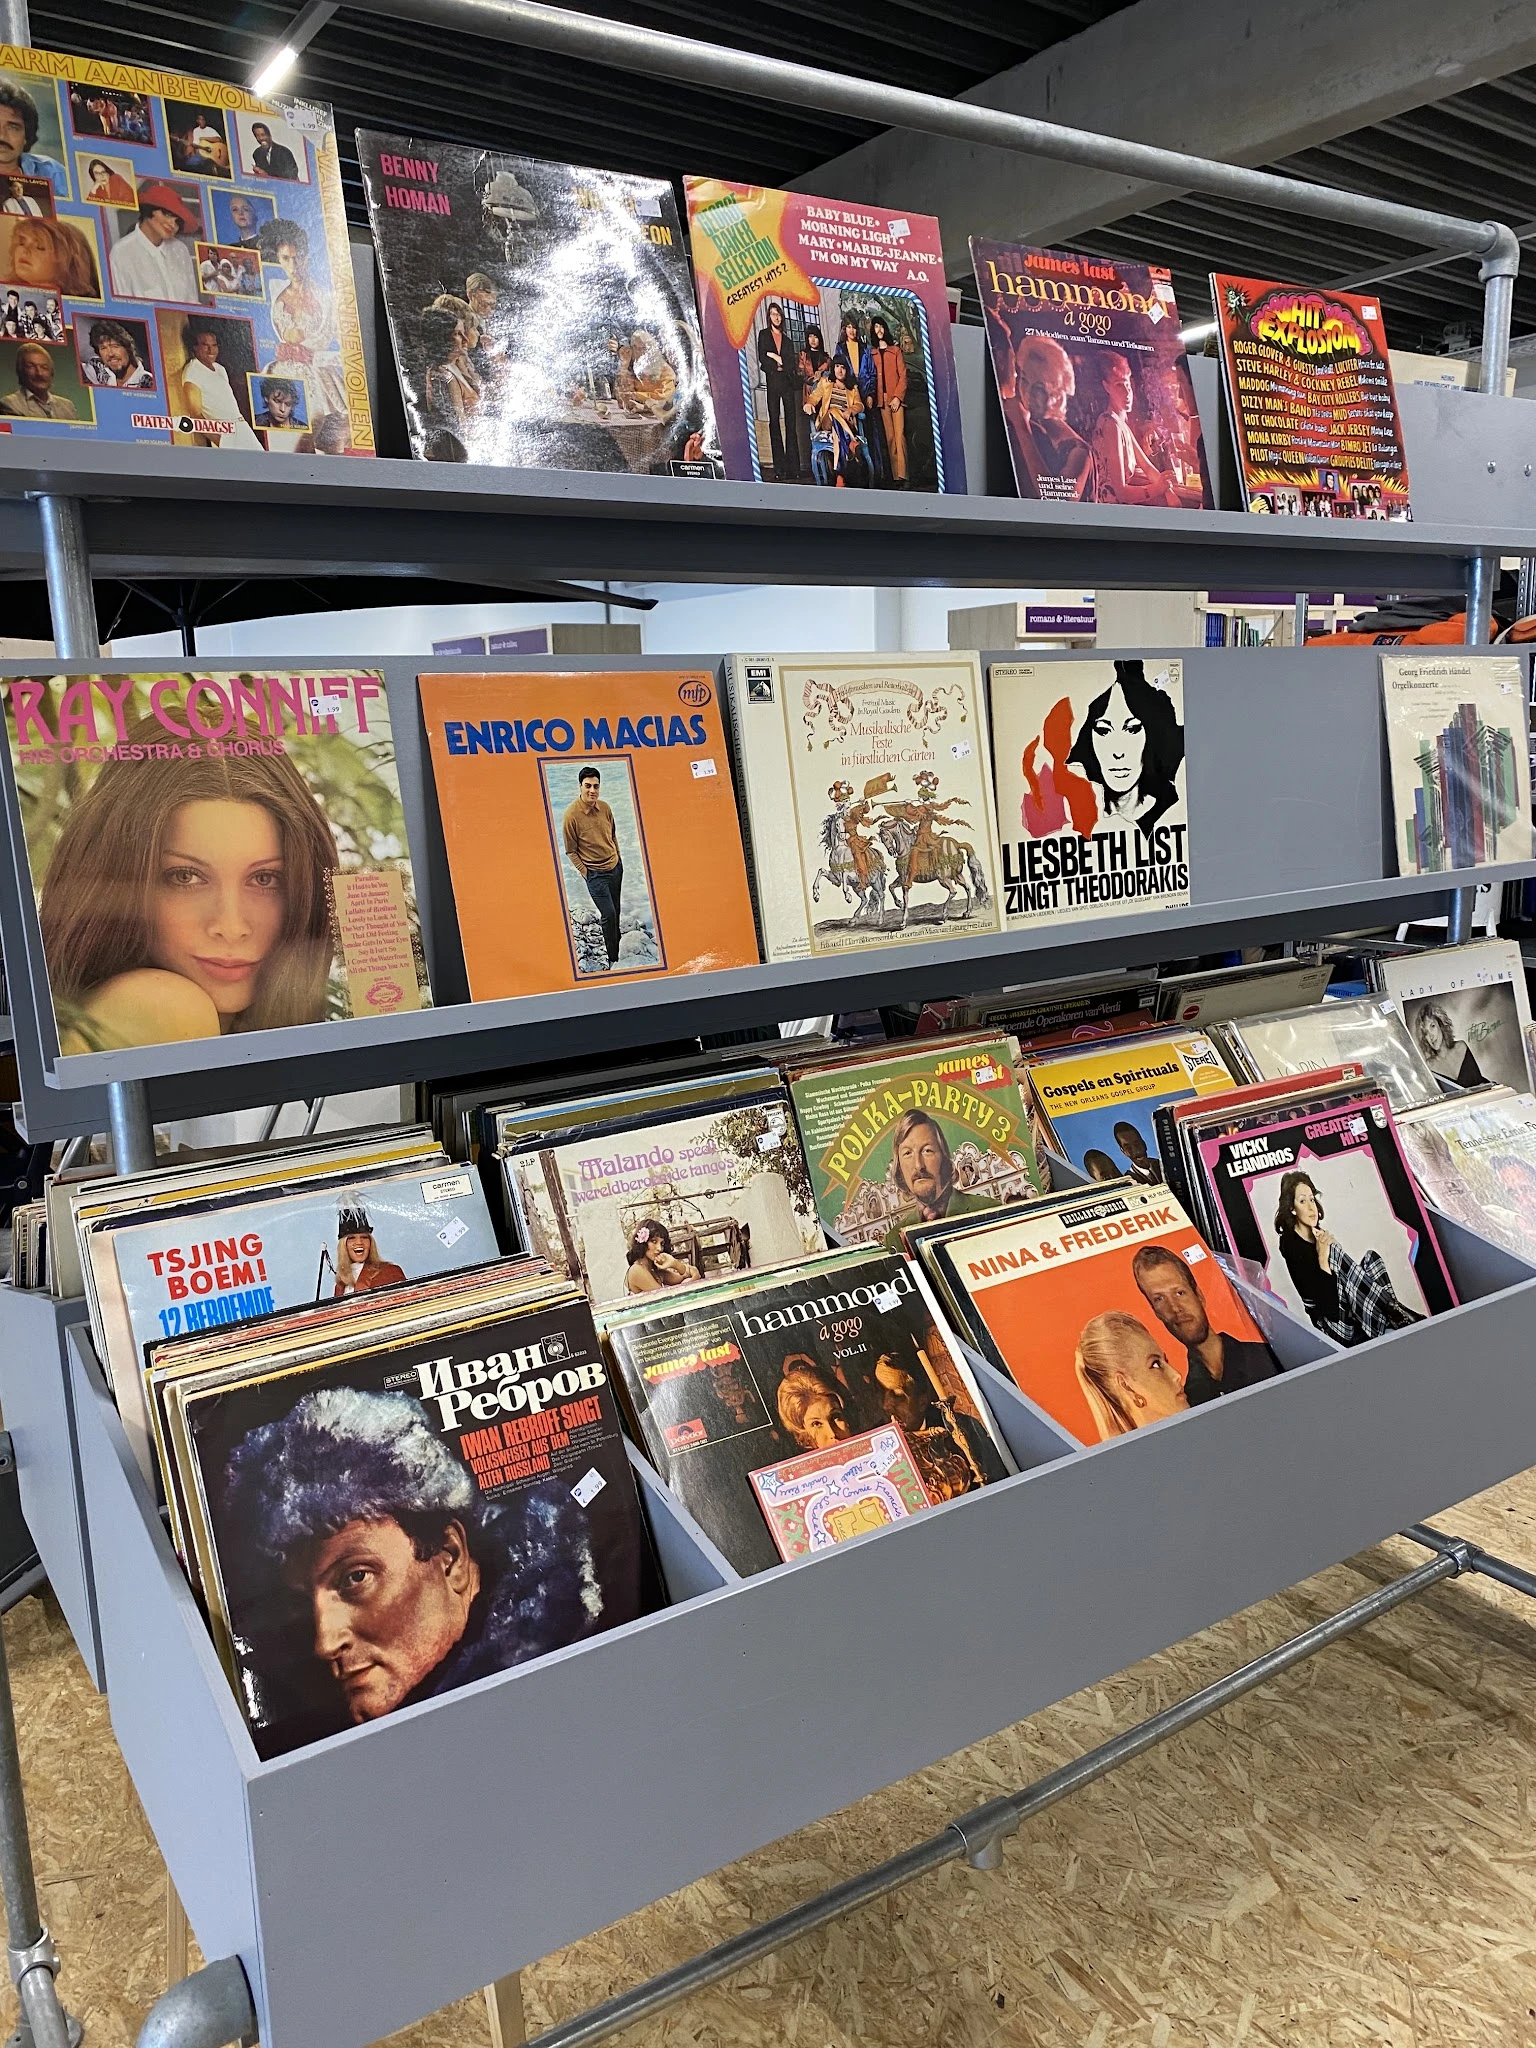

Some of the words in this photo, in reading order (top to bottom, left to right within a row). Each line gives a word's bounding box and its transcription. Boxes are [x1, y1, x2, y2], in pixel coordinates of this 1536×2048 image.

[85, 61, 282, 117] AANBEVOL
[379, 153, 439, 184] BENNY
[385, 185, 452, 216] HOMAN
[696, 191, 745, 238] GEORGE
[806, 205, 843, 221] BABY
[843, 212, 875, 227] BLUE
[711, 218, 758, 262] BAKER
[800, 219, 861, 240] MORNING
[861, 228, 899, 246] LIGHT
[714, 236, 781, 291] SELECTION
[798, 234, 836, 249] MARY
[842, 241, 937, 265] MARIE-JEANNE
[810, 250, 827, 262] I'M
[830, 253, 849, 266] ON
[849, 255, 869, 268] MY
[870, 257, 900, 273] WAY
[726, 276, 765, 306] GREATEST
[765, 268, 781, 285] HITS
[781, 262, 789, 273] 2
[906, 268, 930, 283] A.O.
[986, 260, 1172, 319] hammond
[1078, 311, 1112, 337] gogo
[1290, 298, 1325, 330] HIT
[1024, 327, 1035, 337] 27
[1035, 328, 1069, 342] Melodien
[1085, 334, 1111, 347] Tanzen
[1111, 338, 1124, 349] und
[1124, 339, 1155, 352] Träumen
[1261, 310, 1361, 355] EXPLOSION
[1233, 340, 1258, 355] ROGER
[1258, 344, 1284, 365] GLOVER
[1285, 356, 1291, 367] &
[1293, 359, 1315, 376] GUESTS
[1334, 357, 1359, 375] LUCIFER
[1236, 358, 1263, 373] STEVE
[1263, 362, 1292, 383] HARLEY
[1293, 373, 1299, 386] &
[1301, 376, 1336, 392] COCKNEY
[1336, 374, 1359, 390] REBEL
[1238, 376, 1271, 392] MADDOG
[1307, 391, 1321, 405] BAY
[1321, 393, 1335, 406] CITY
[1335, 390, 1361, 406] ROLLERS
[1240, 394, 1263, 409] DIZZY
[1264, 397, 1288, 412] MAN'S
[1289, 401, 1312, 418] BAND
[1333, 407, 1348, 421] MUD
[133, 415, 174, 429] PLATEN
[194, 419, 235, 434] DAAGSE
[1243, 412, 1260, 426] HOT
[1261, 414, 1299, 430] CHOCOLATE
[1329, 423, 1347, 436] JACK
[1347, 423, 1371, 437] JERSEY
[1247, 430, 1271, 445] MONA
[1270, 432, 1292, 446] KIRBY
[1340, 439, 1361, 453] BIMBO
[1361, 441, 1372, 453] JET
[1249, 447, 1269, 462] PILOT
[1282, 449, 1305, 465] QUEEN
[1030, 615, 1056, 623] romans
[750, 669, 767, 677] EMI
[1391, 680, 1440, 691] Orgelkonzerte
[1398, 667, 1418, 678] Georg
[1419, 666, 1448, 676] Friedrich
[1448, 666, 1472, 676] Händel
[683, 683, 707, 702] mfp
[10, 678, 136, 747] RAY
[149, 675, 381, 740] CONNIFF
[326, 705, 341, 714] 1.99
[444, 718, 575, 755] ENRICO
[584, 714, 707, 750] MACIAS
[850, 719, 912, 736] Musikalische
[871, 736, 893, 749] Feste
[19, 746, 55, 766] HIS
[58, 742, 182, 766] ORCHESTRA
[187, 742, 202, 759] &
[206, 739, 287, 759] CHORUS
[850, 749, 901, 768] fürstlichen
[900, 748, 936, 762] Gärten
[1002, 829, 1128, 885] LIESBETH
[1134, 824, 1188, 868] LIST
[1004, 879, 1061, 915] ZINGT
[1066, 863, 1189, 908] THEODORAKIS
[1400, 985, 1433, 998] LADY
[1450, 979, 1466, 989] OF
[1036, 1011, 1084, 1028] Operakoren
[1099, 1000, 1122, 1014] Verdi
[1183, 1050, 1220, 1072] STEREO
[1043, 1077, 1096, 1098] Gospels
[1097, 1076, 1113, 1088] en
[1113, 1061, 1180, 1086] Spirituals
[1050, 1102, 1064, 1111] THE
[1064, 1099, 1079, 1108] NEW
[1080, 1092, 1110, 1105] ORLEANS
[1110, 1087, 1135, 1099] GOSPEL
[1135, 1083, 1156, 1093] GROUP
[828, 1079, 994, 1182] POLKA-PARTY
[991, 1118, 1012, 1143] 3
[1162, 1119, 1177, 1158] PHILIPS
[1455, 1132, 1503, 1150] Tennessee
[1501, 1125, 1528, 1139] Ernie
[1226, 1147, 1295, 1179] LEANDROS
[1229, 1136, 1269, 1160] VICKY
[577, 1145, 675, 1182] Malando
[432, 1179, 461, 1190] carmen
[574, 1168, 689, 1203] wereldberoemde
[690, 1157, 735, 1178] tango's
[146, 1232, 264, 1277] TSJING
[967, 1248, 1039, 1281] NINA
[1041, 1240, 1062, 1260] &
[1059, 1206, 1180, 1254] FREDERIK
[166, 1260, 267, 1301] BOEM!
[734, 1267, 917, 1339] hammond
[158, 1306, 181, 1338] 12
[831, 1315, 863, 1343] gogo
[543, 1334, 564, 1345] CBS
[832, 1343, 868, 1360] VOL.II
[385, 1371, 418, 1385] STEREO
[413, 1341, 547, 1400] Иван
[433, 1361, 607, 1433] Ребров
[459, 1425, 503, 1461] IWAN
[501, 1407, 562, 1448] REBROFF
[560, 1395, 603, 1430] SINGT
[671, 1430, 704, 1446] polydor
[470, 1444, 531, 1475] VOLKSWEISEN
[531, 1437, 549, 1456] AUS
[550, 1430, 571, 1451] DEM
[477, 1468, 503, 1491] ALTEN
[504, 1453, 551, 1485] RUSSLAND
[590, 1480, 604, 1495] 1.99
[841, 1484, 873, 1498] Connie
[874, 1481, 902, 1518] Francis
[811, 1495, 831, 1531] Slade
